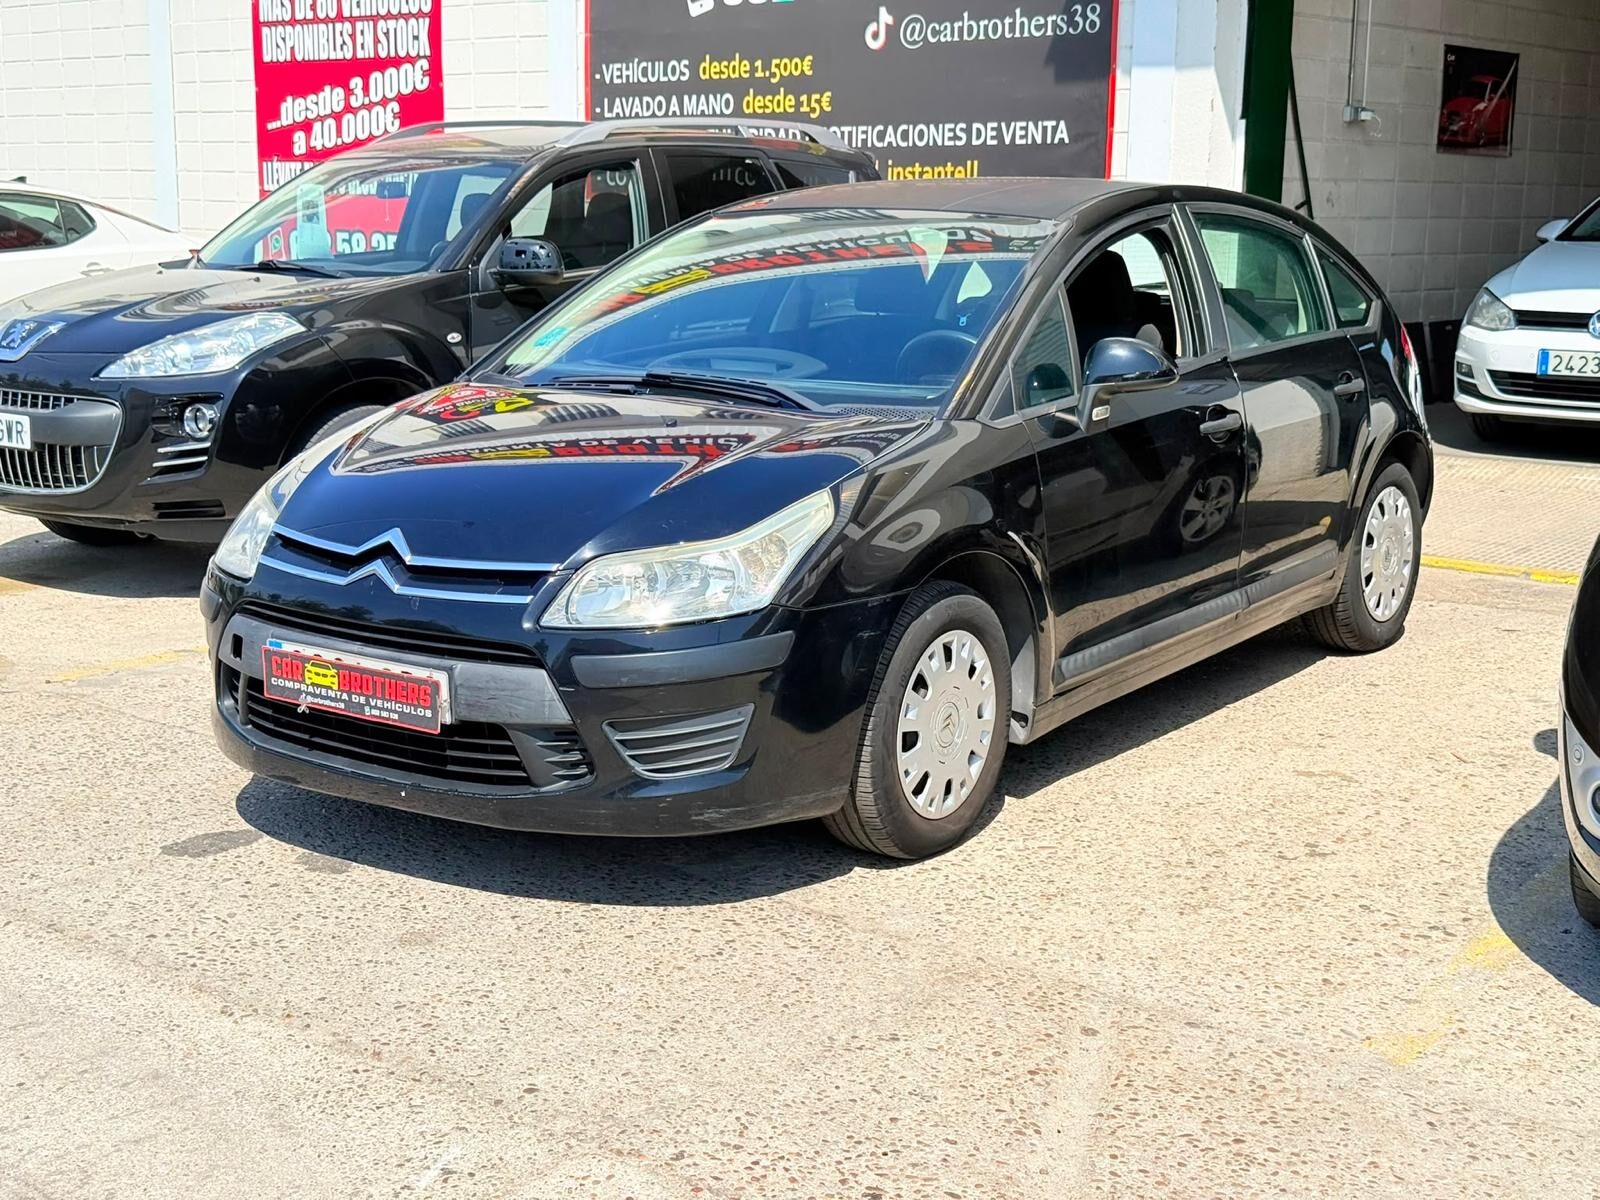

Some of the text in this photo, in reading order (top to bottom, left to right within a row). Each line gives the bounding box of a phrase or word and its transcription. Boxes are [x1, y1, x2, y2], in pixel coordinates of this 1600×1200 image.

[261, 17, 431, 63] DISPONIBLES EN STOCK
[899, 3, 1101, 49] @carbrothers38
[349, 58, 430, 108] 3.000€
[602, 53, 813, 84] VEHÍCULOS desde 1.500€
[603, 88, 832, 119] LAVADO A MANO desde 15€
[292, 101, 401, 156] a 40.000€
[830, 123, 967, 148] TIFICACIONES
[971, 122, 998, 146] DE
[1001, 120, 1070, 145] VENTA
[1551, 354, 1600, 375] 2423
[271, 655, 432, 707] CAR BROTHERS
[271, 677, 349, 701] COMPRAVENTA
[351, 693, 367, 704] DE
[369, 697, 433, 718] VEHÍCULOS
